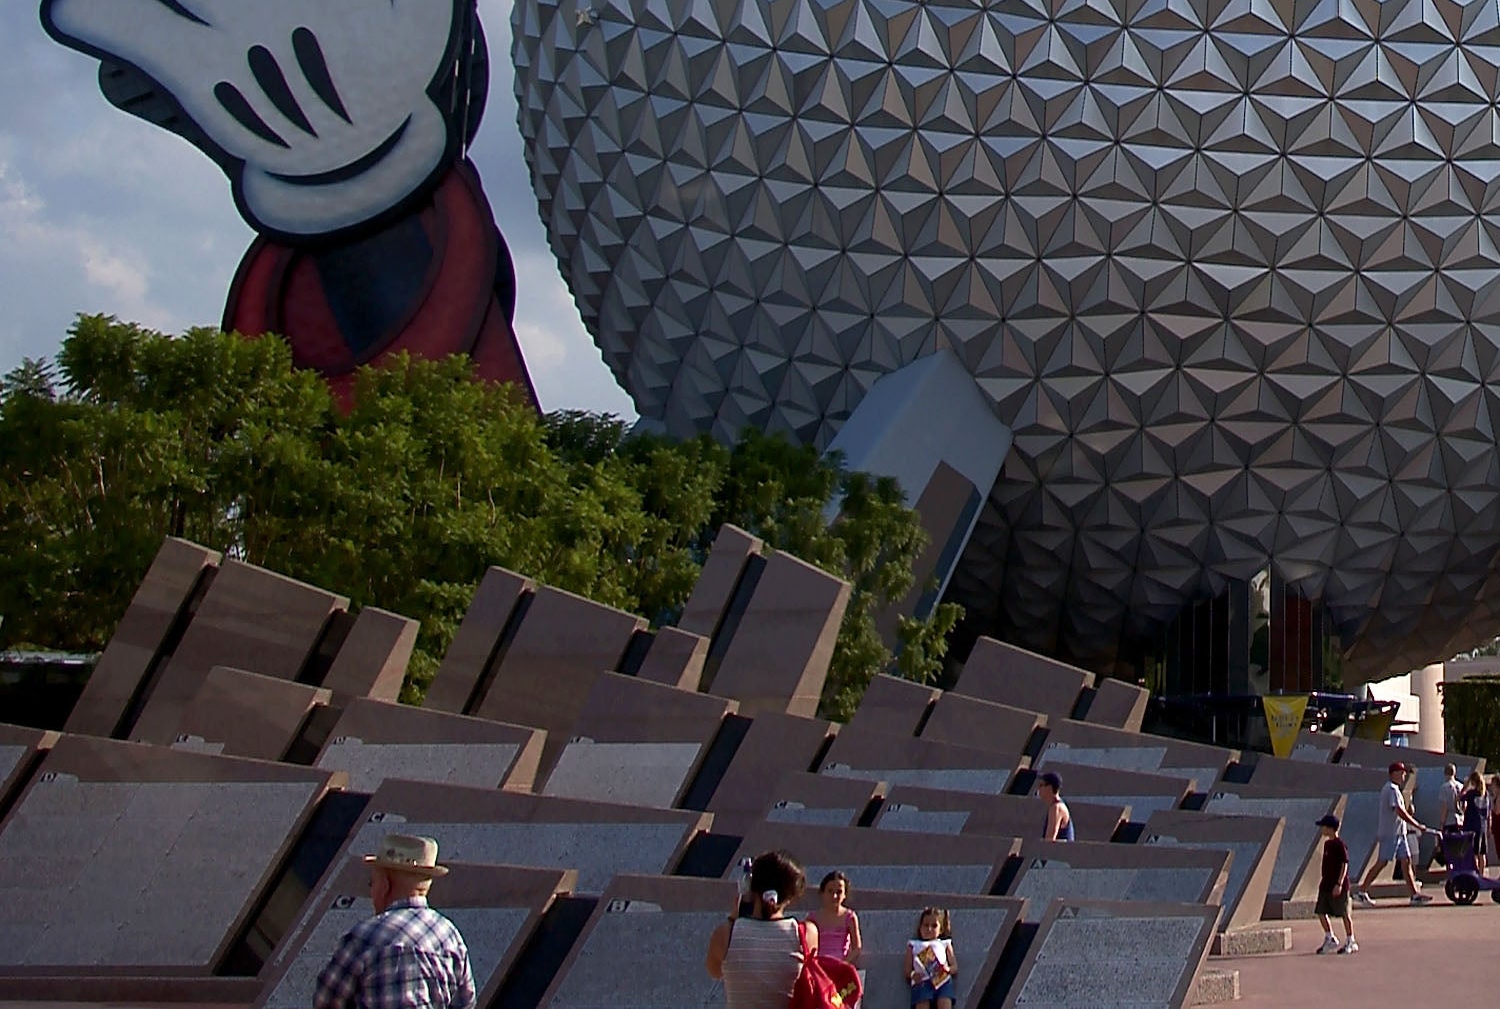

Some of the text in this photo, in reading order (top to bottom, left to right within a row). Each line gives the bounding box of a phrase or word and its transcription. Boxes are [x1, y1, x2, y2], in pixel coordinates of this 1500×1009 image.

[44, 772, 54, 781] D
[371, 812, 382, 822] C
[336, 895, 350, 909] C
[612, 900, 625, 912] B
[1062, 907, 1074, 919] A
